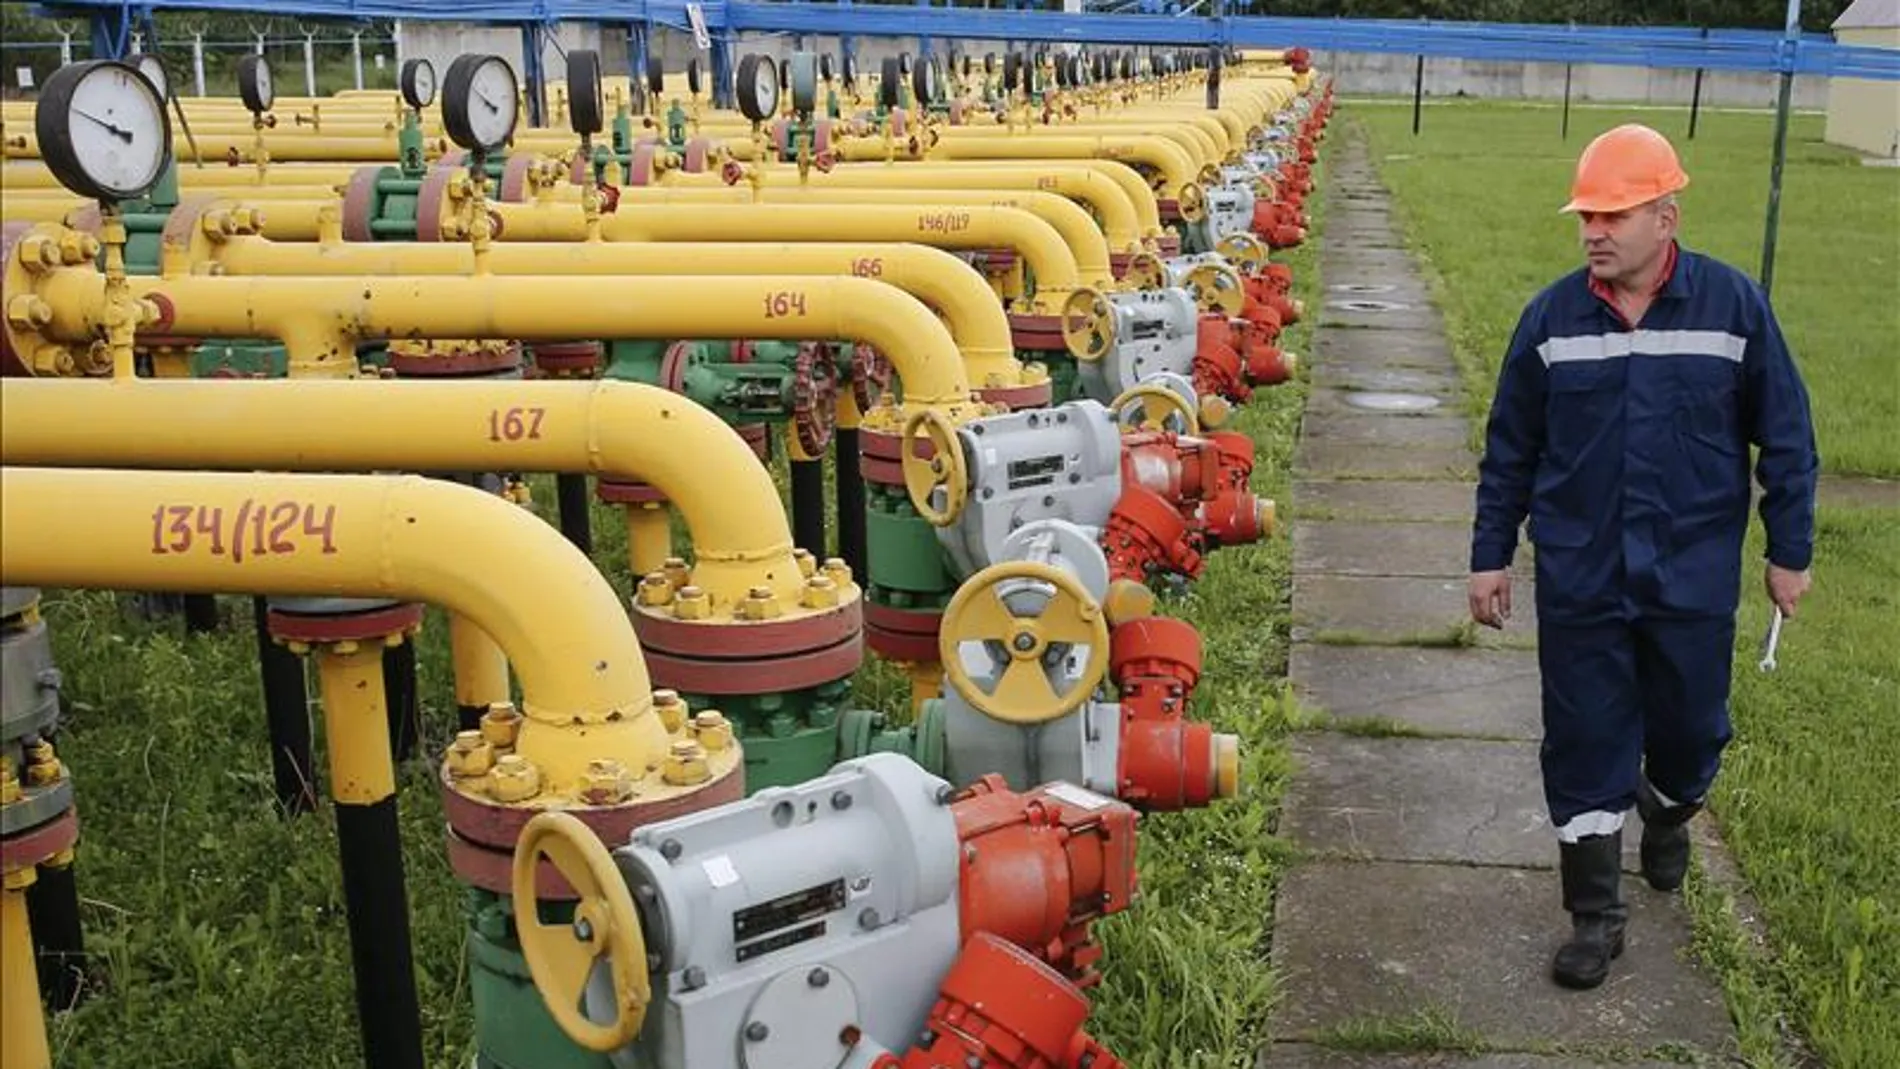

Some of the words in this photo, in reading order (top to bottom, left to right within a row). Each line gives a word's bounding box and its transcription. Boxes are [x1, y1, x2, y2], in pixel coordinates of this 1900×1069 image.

[851, 257, 882, 277] 166
[764, 291, 806, 318] 164
[487, 407, 546, 442] 167
[151, 498, 338, 564] 134/124
